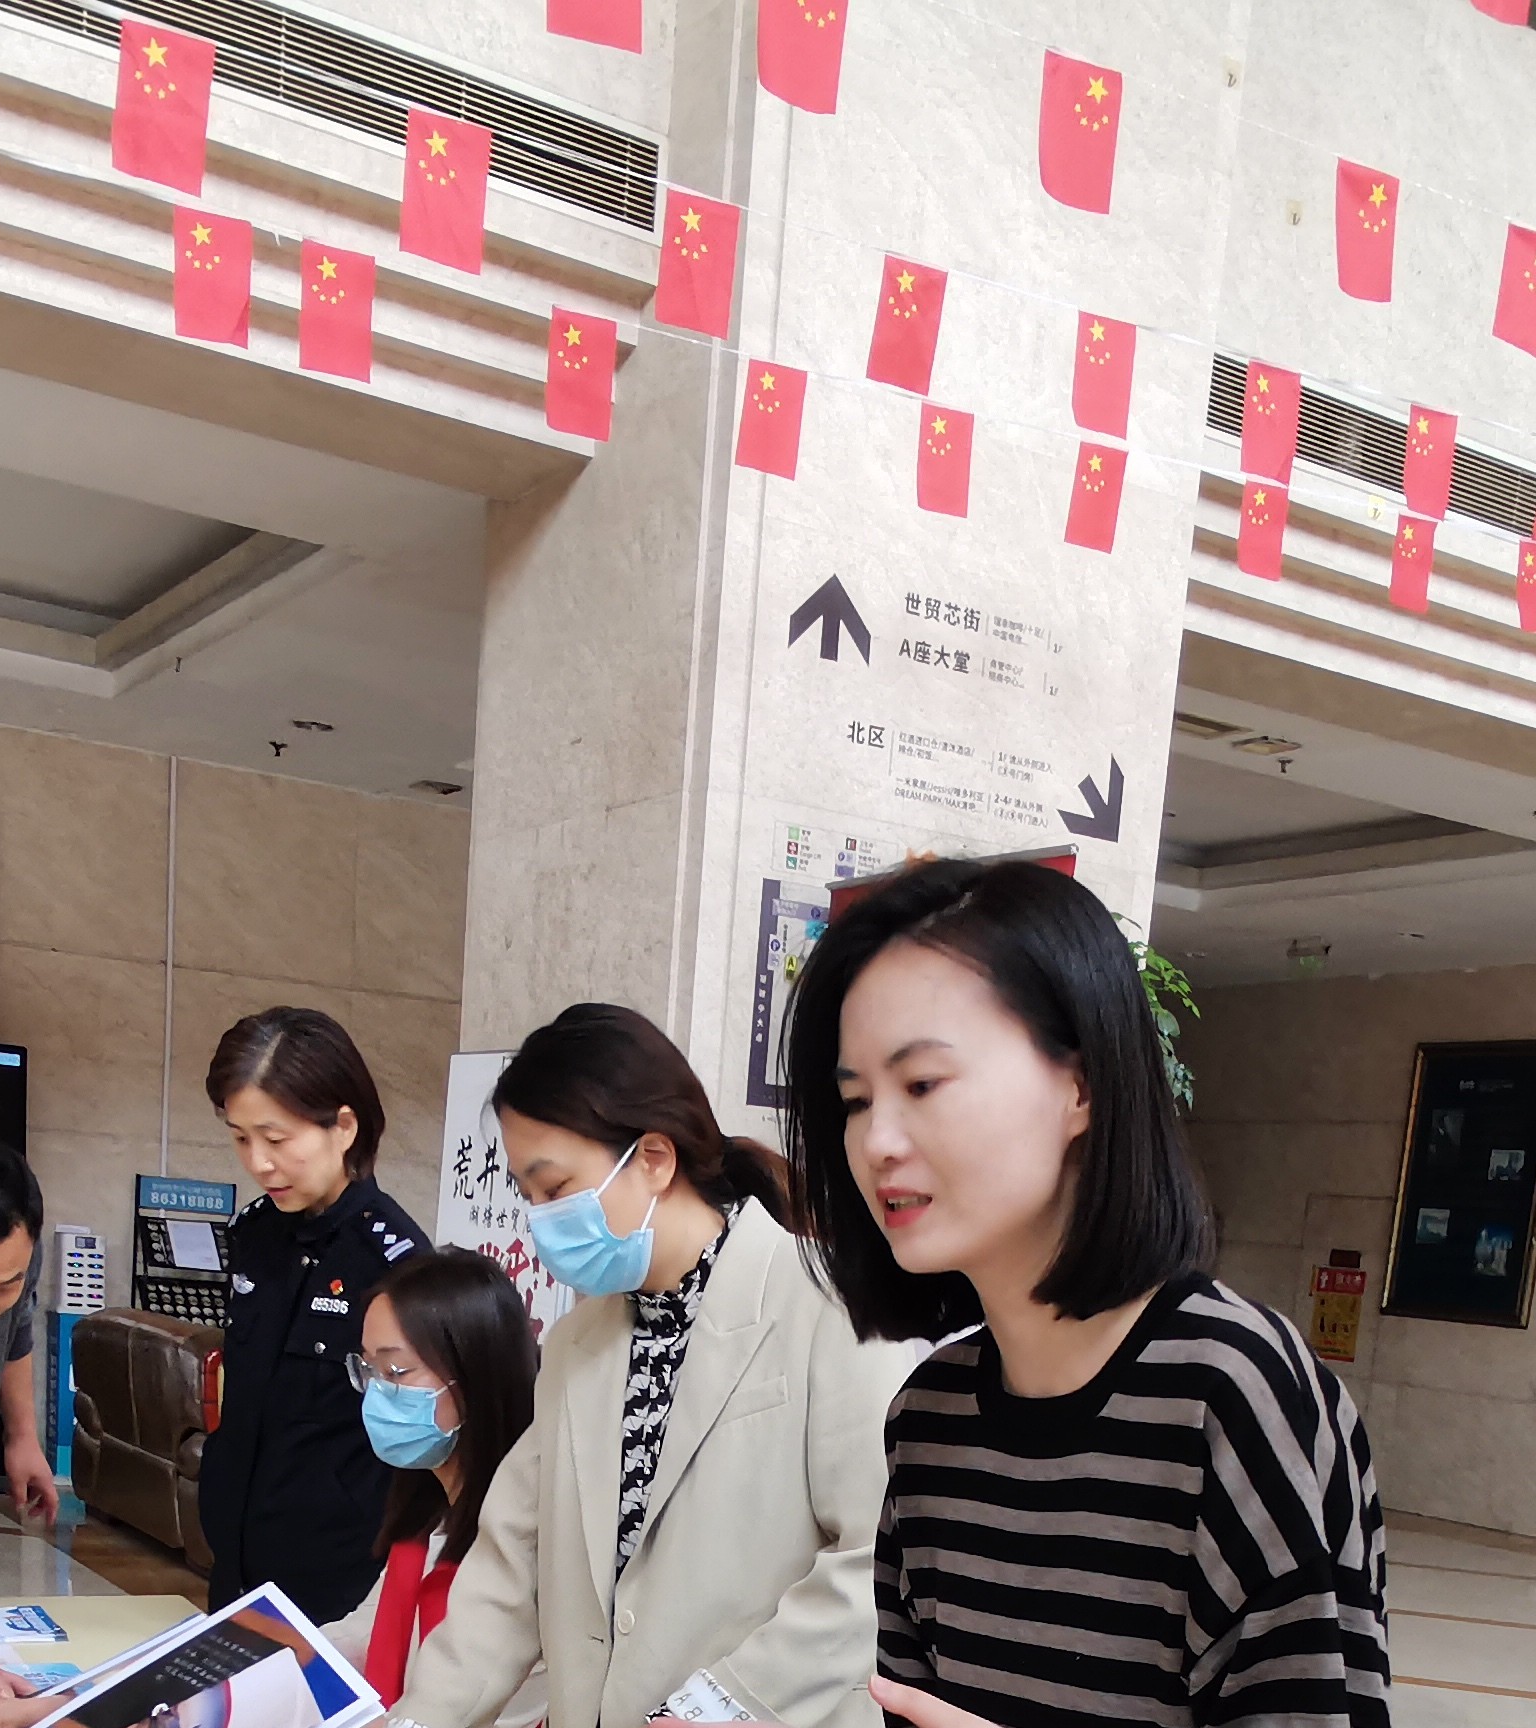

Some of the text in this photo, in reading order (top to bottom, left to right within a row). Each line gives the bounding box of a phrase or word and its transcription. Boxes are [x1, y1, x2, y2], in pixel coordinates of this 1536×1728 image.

[904, 592, 982, 633] 世贸芯街
[898, 638, 971, 674] A座大堂
[847, 720, 885, 749] 北区
